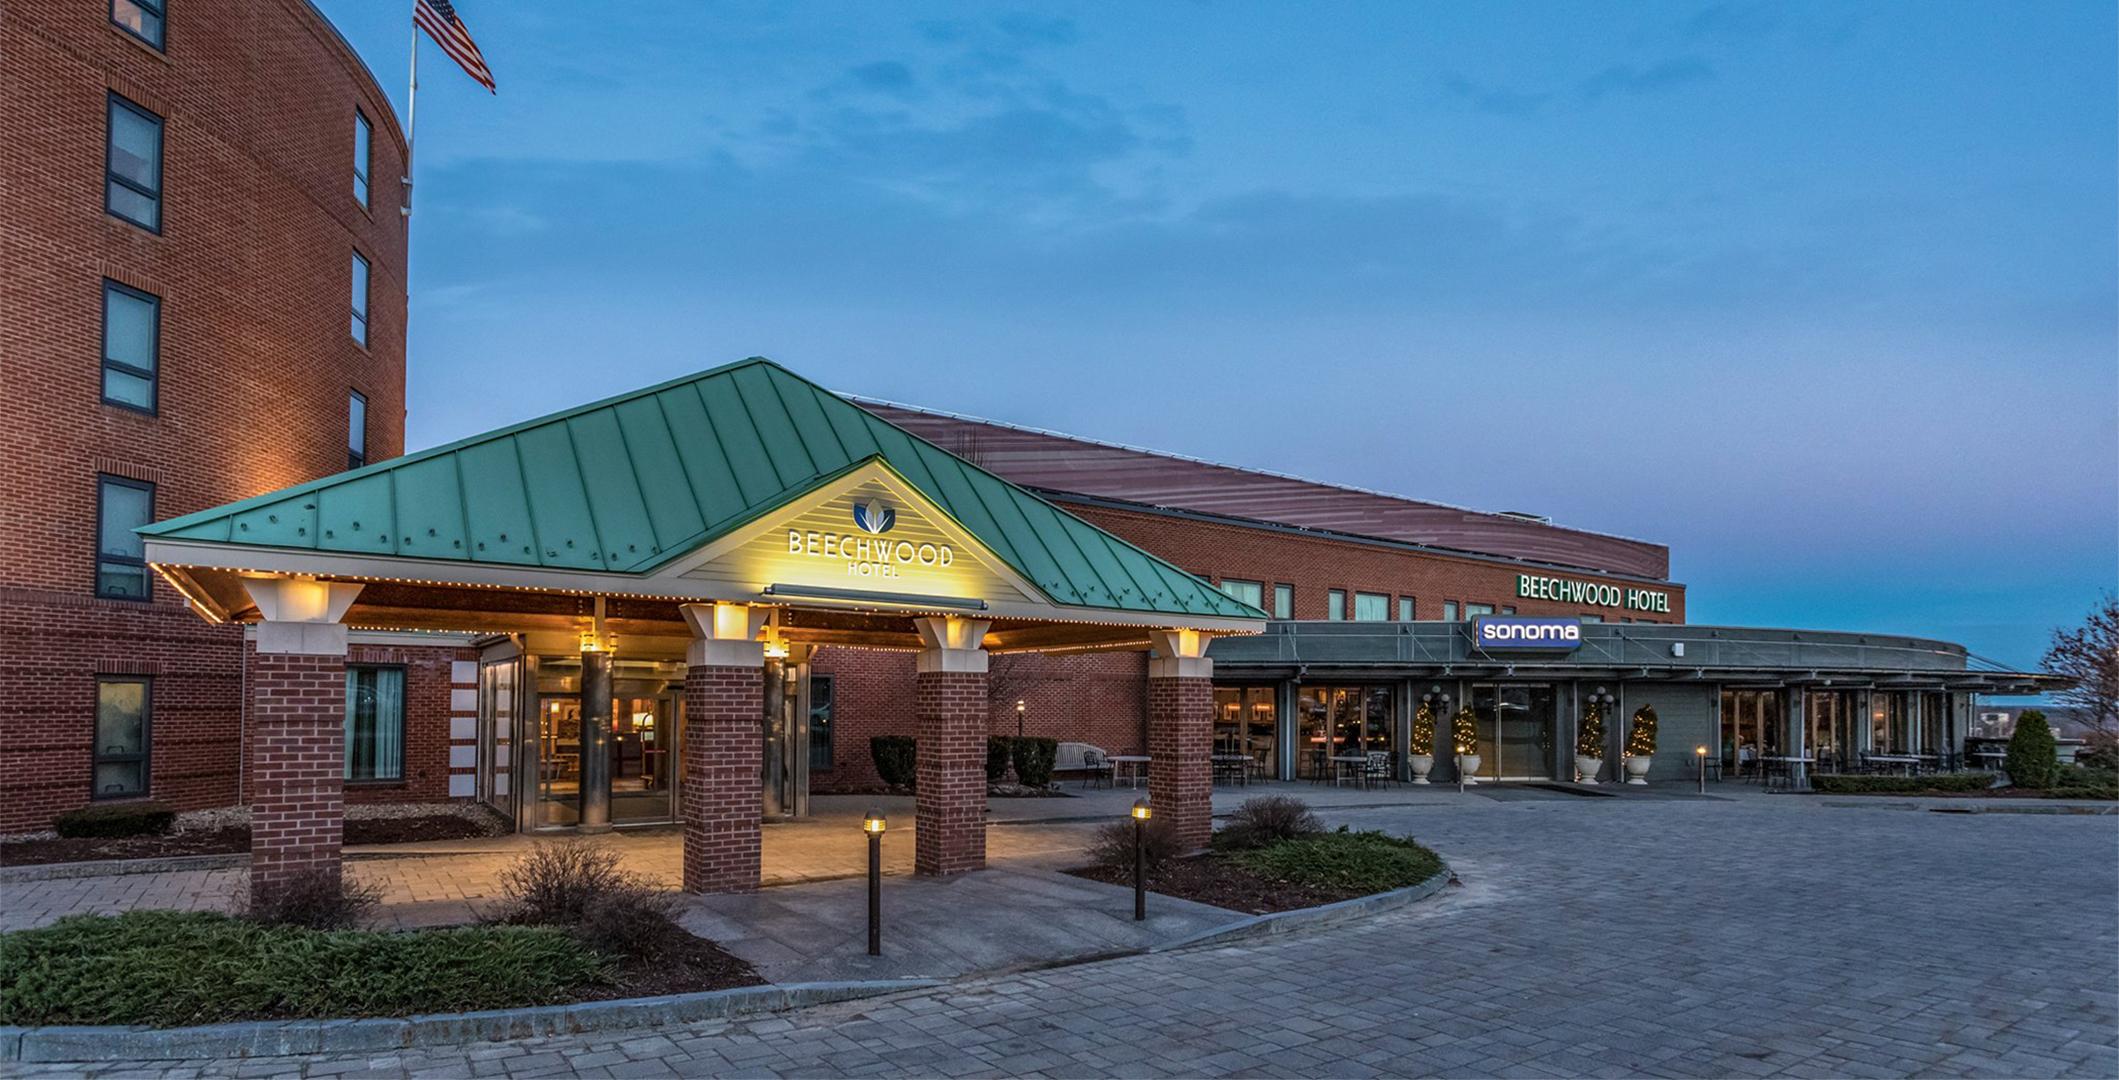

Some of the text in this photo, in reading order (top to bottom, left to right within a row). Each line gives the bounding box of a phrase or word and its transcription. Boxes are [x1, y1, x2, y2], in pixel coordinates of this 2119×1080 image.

[788, 530, 953, 567] BEECHWOOD
[847, 560, 899, 579] HOTEL
[1518, 574, 1671, 613] BEECHWOOD HOTEL
[1483, 623, 1580, 640] sonoma
